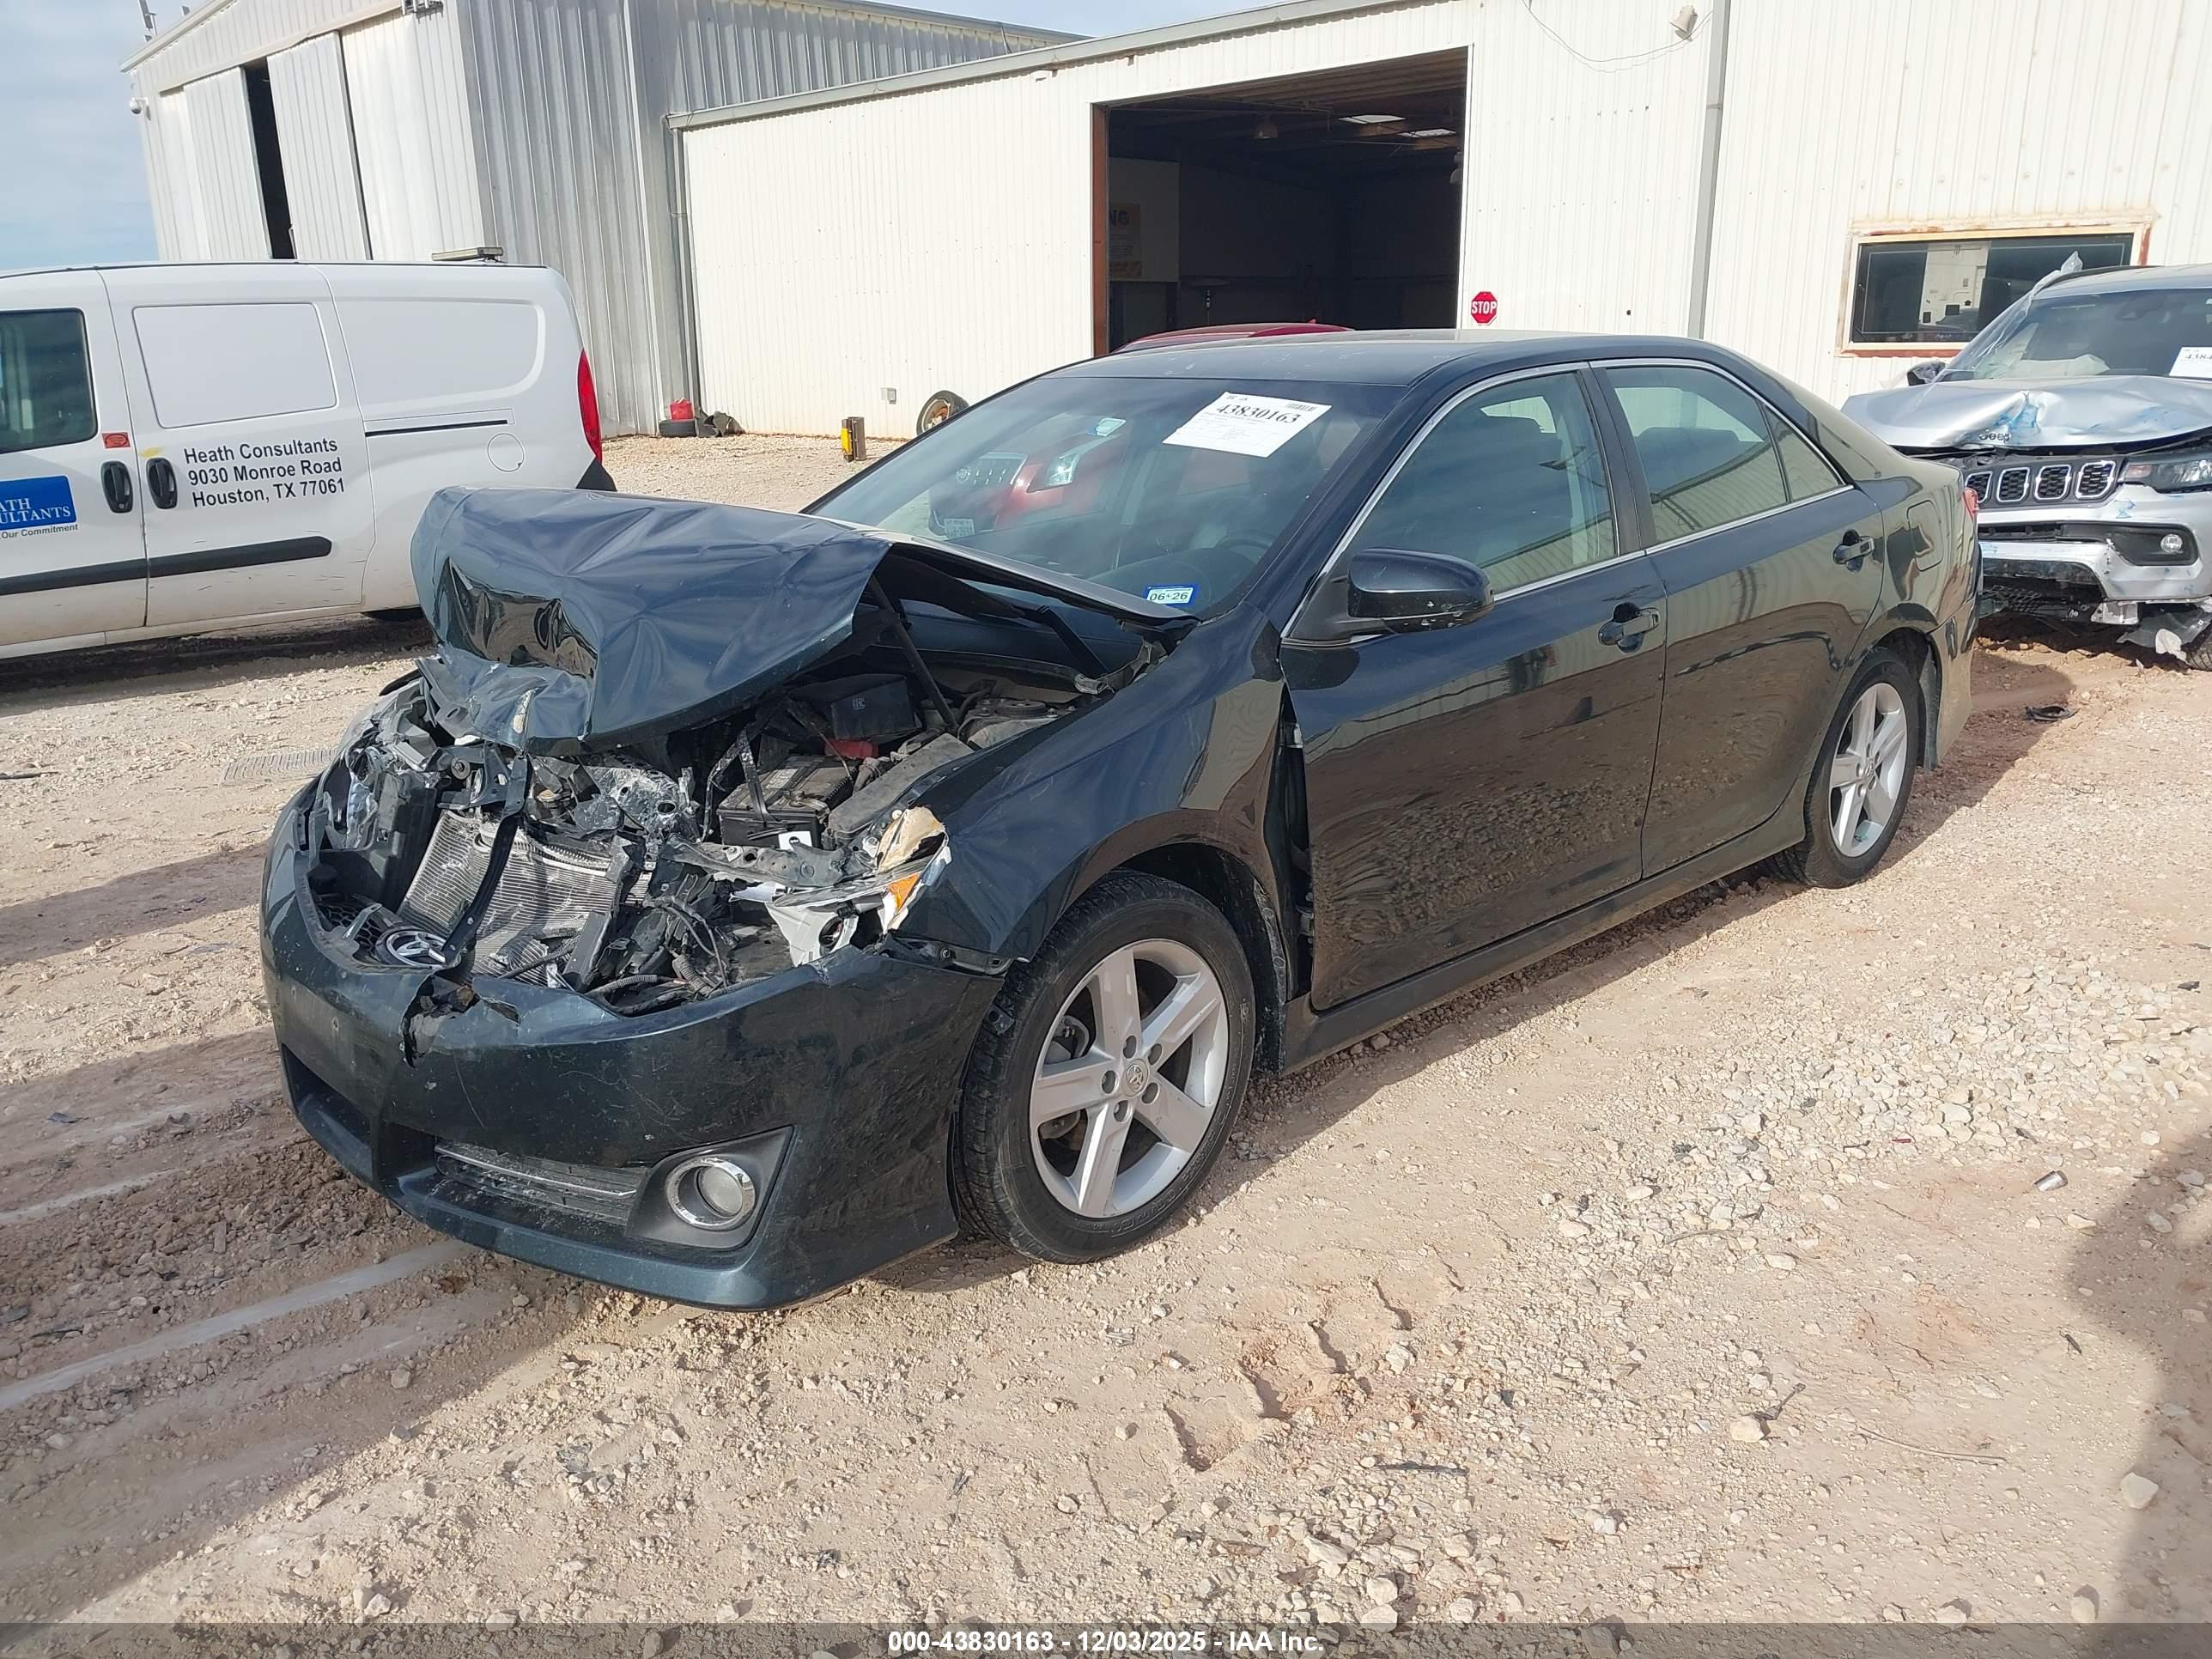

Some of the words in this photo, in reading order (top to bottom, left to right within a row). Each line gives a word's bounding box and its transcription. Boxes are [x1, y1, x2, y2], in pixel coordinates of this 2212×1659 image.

[1471, 301, 1498, 314] STOP
[1216, 404, 1302, 423] 43830163
[184, 446, 235, 464] Heath
[240, 438, 337, 459] Consultants
[188, 466, 229, 486] 9030
[233, 464, 296, 482] Monroe
[300, 456, 343, 476] Road
[191, 488, 270, 507] Houston,
[272, 482, 296, 499] TX
[300, 477, 345, 496] 77061
[21, 524, 78, 537] Commitment
